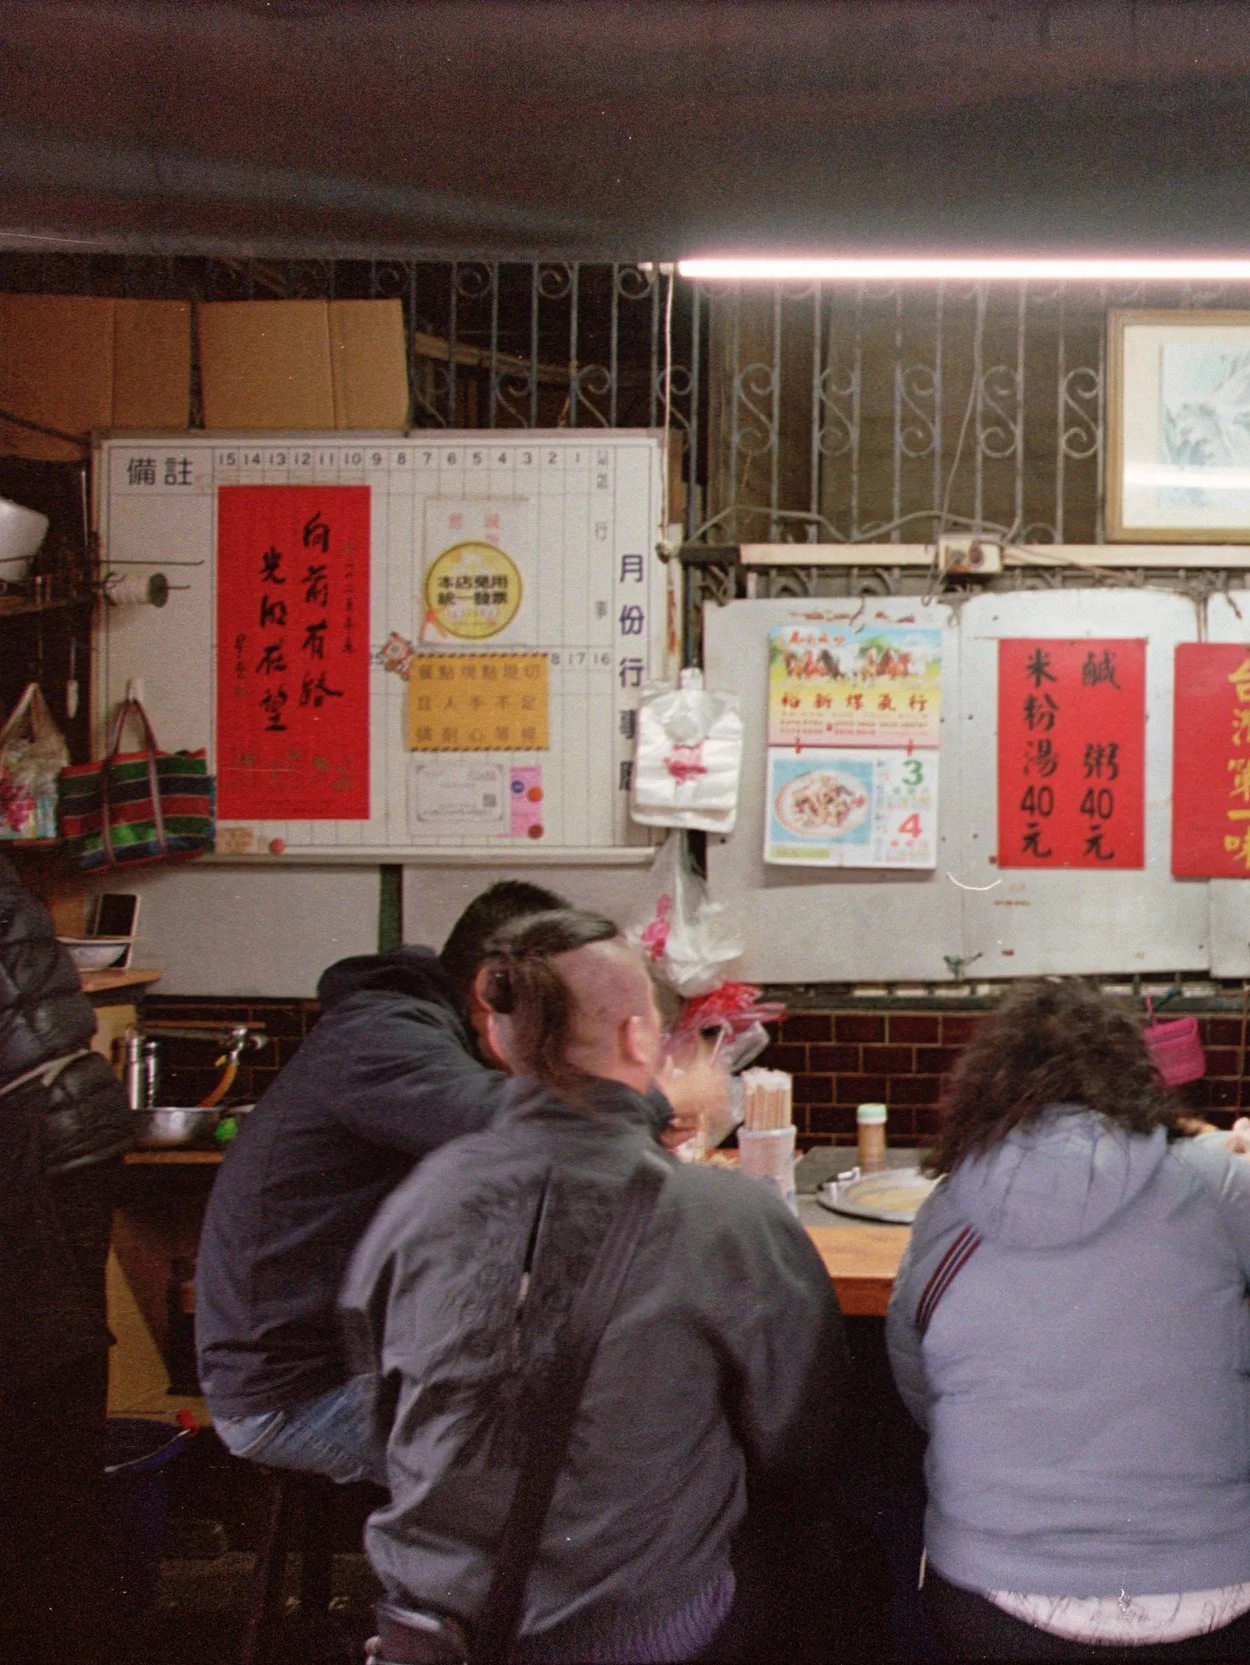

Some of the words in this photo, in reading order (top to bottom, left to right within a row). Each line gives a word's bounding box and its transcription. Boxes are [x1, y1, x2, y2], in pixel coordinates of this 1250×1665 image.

[218, 452, 236, 466] 15
[244, 452, 261, 466] 14
[269, 452, 286, 466] 13
[294, 452, 312, 466] 12
[319, 452, 334, 466] 11
[345, 452, 362, 466] 10
[371, 452, 382, 466] 9
[397, 452, 406, 465] 8
[423, 452, 431, 465] 7
[447, 452, 457, 465] 6
[472, 452, 482, 465] 5
[498, 452, 507, 465] 4
[524, 452, 532, 465] 3
[548, 452, 557, 465] 2
[574, 452, 580, 464] 1
[128, 457, 193, 486] 備註
[436, 575, 508, 589] 本店免用
[437, 591, 508, 605] 統一發票
[303, 511, 344, 707] 向前有路
[568, 652, 586, 665] 17
[593, 652, 611, 666] 16
[902, 759, 923, 786] 3
[898, 812, 923, 838] 4
